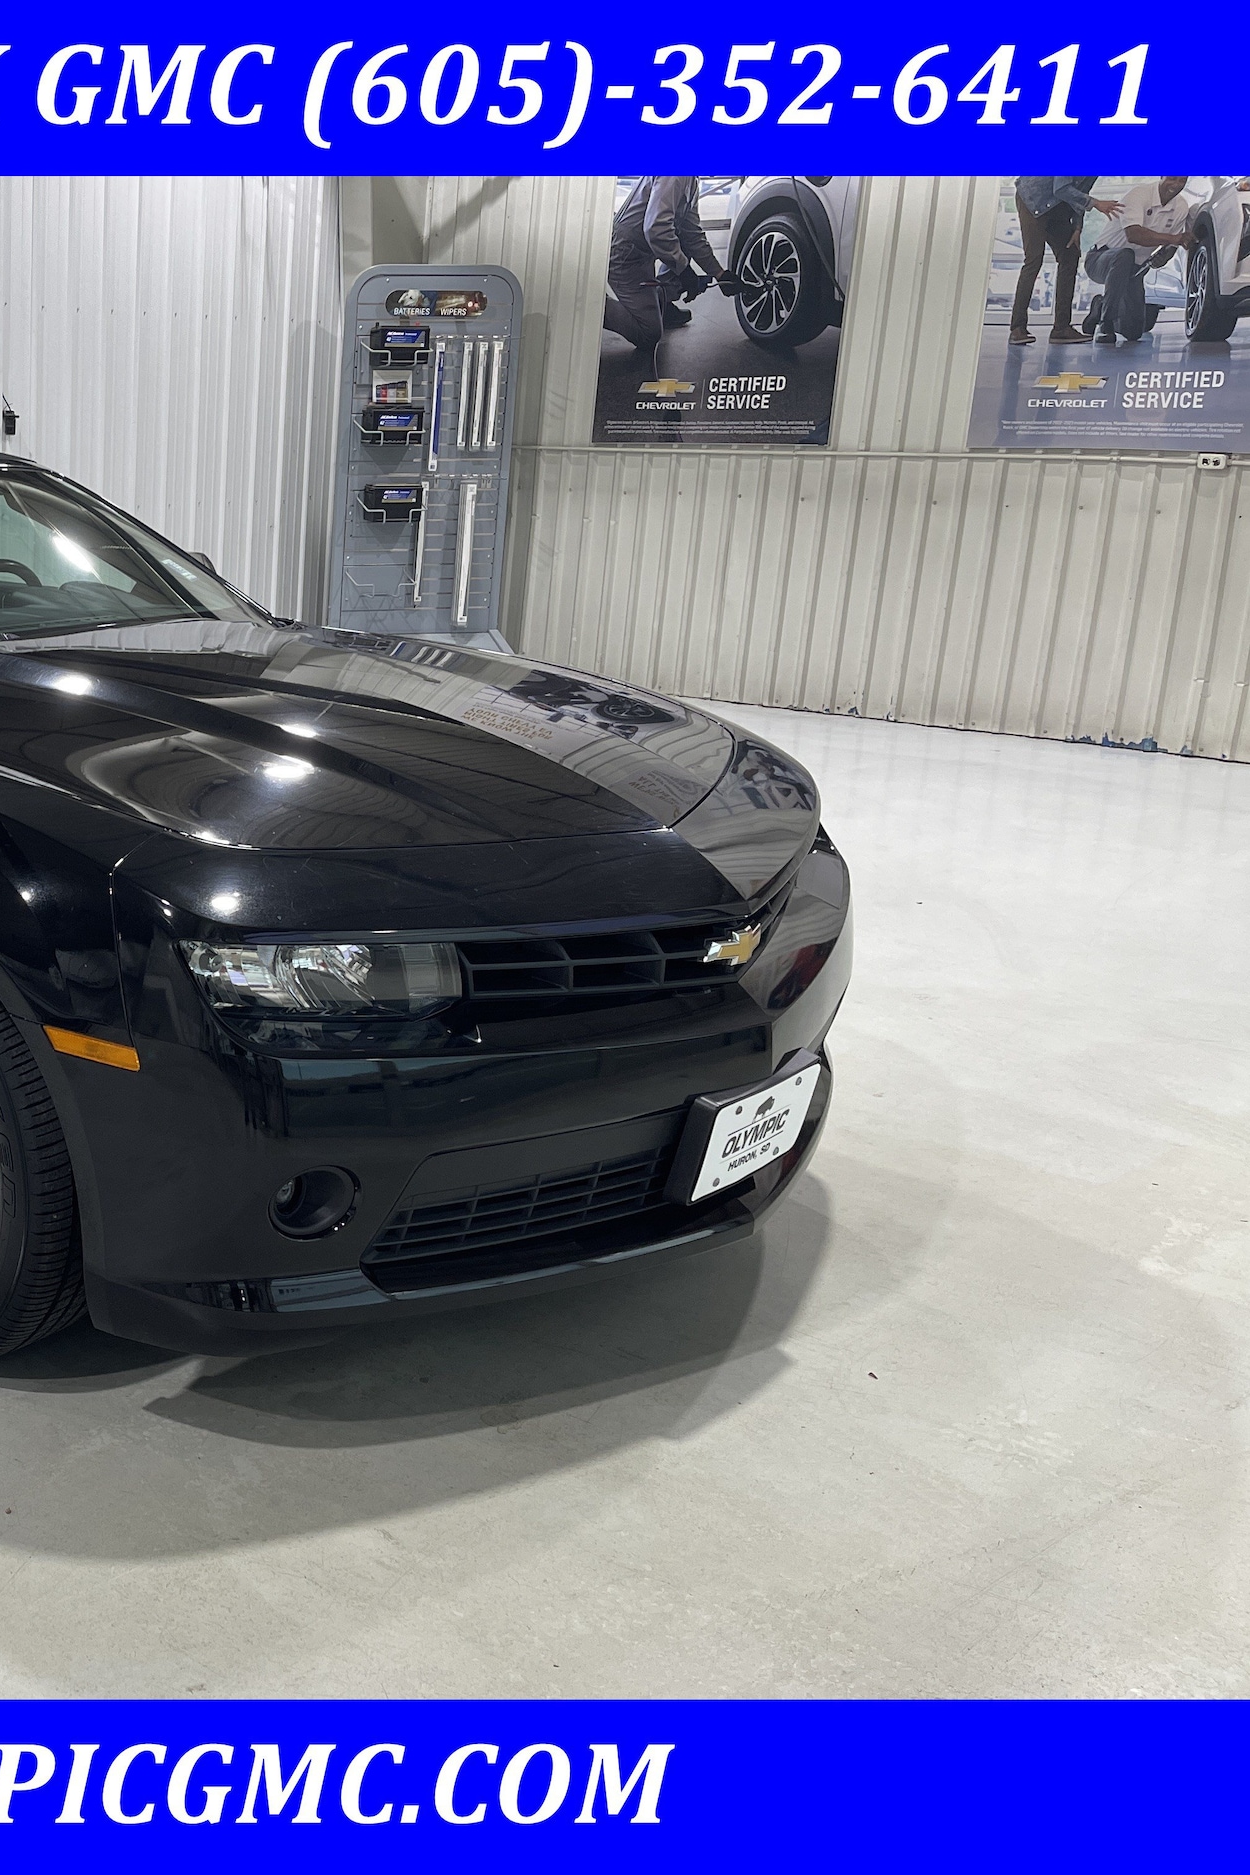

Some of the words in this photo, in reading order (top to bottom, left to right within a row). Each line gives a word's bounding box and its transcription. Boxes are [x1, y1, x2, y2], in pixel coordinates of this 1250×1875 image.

[394, 307, 430, 316] BATTERIES
[440, 308, 467, 316] WIPERS
[708, 376, 787, 393] CERTIFIED
[1125, 371, 1225, 389] CERTIFIED
[635, 401, 696, 411] CHEVROLET
[707, 394, 771, 410] SERVICE
[1027, 399, 1108, 408] CHEVROLET
[1122, 392, 1205, 409] SERVICE
[721, 1108, 790, 1159] OLYMPIC
[727, 1149, 758, 1172] HURON,
[760, 1142, 771, 1155] SD
